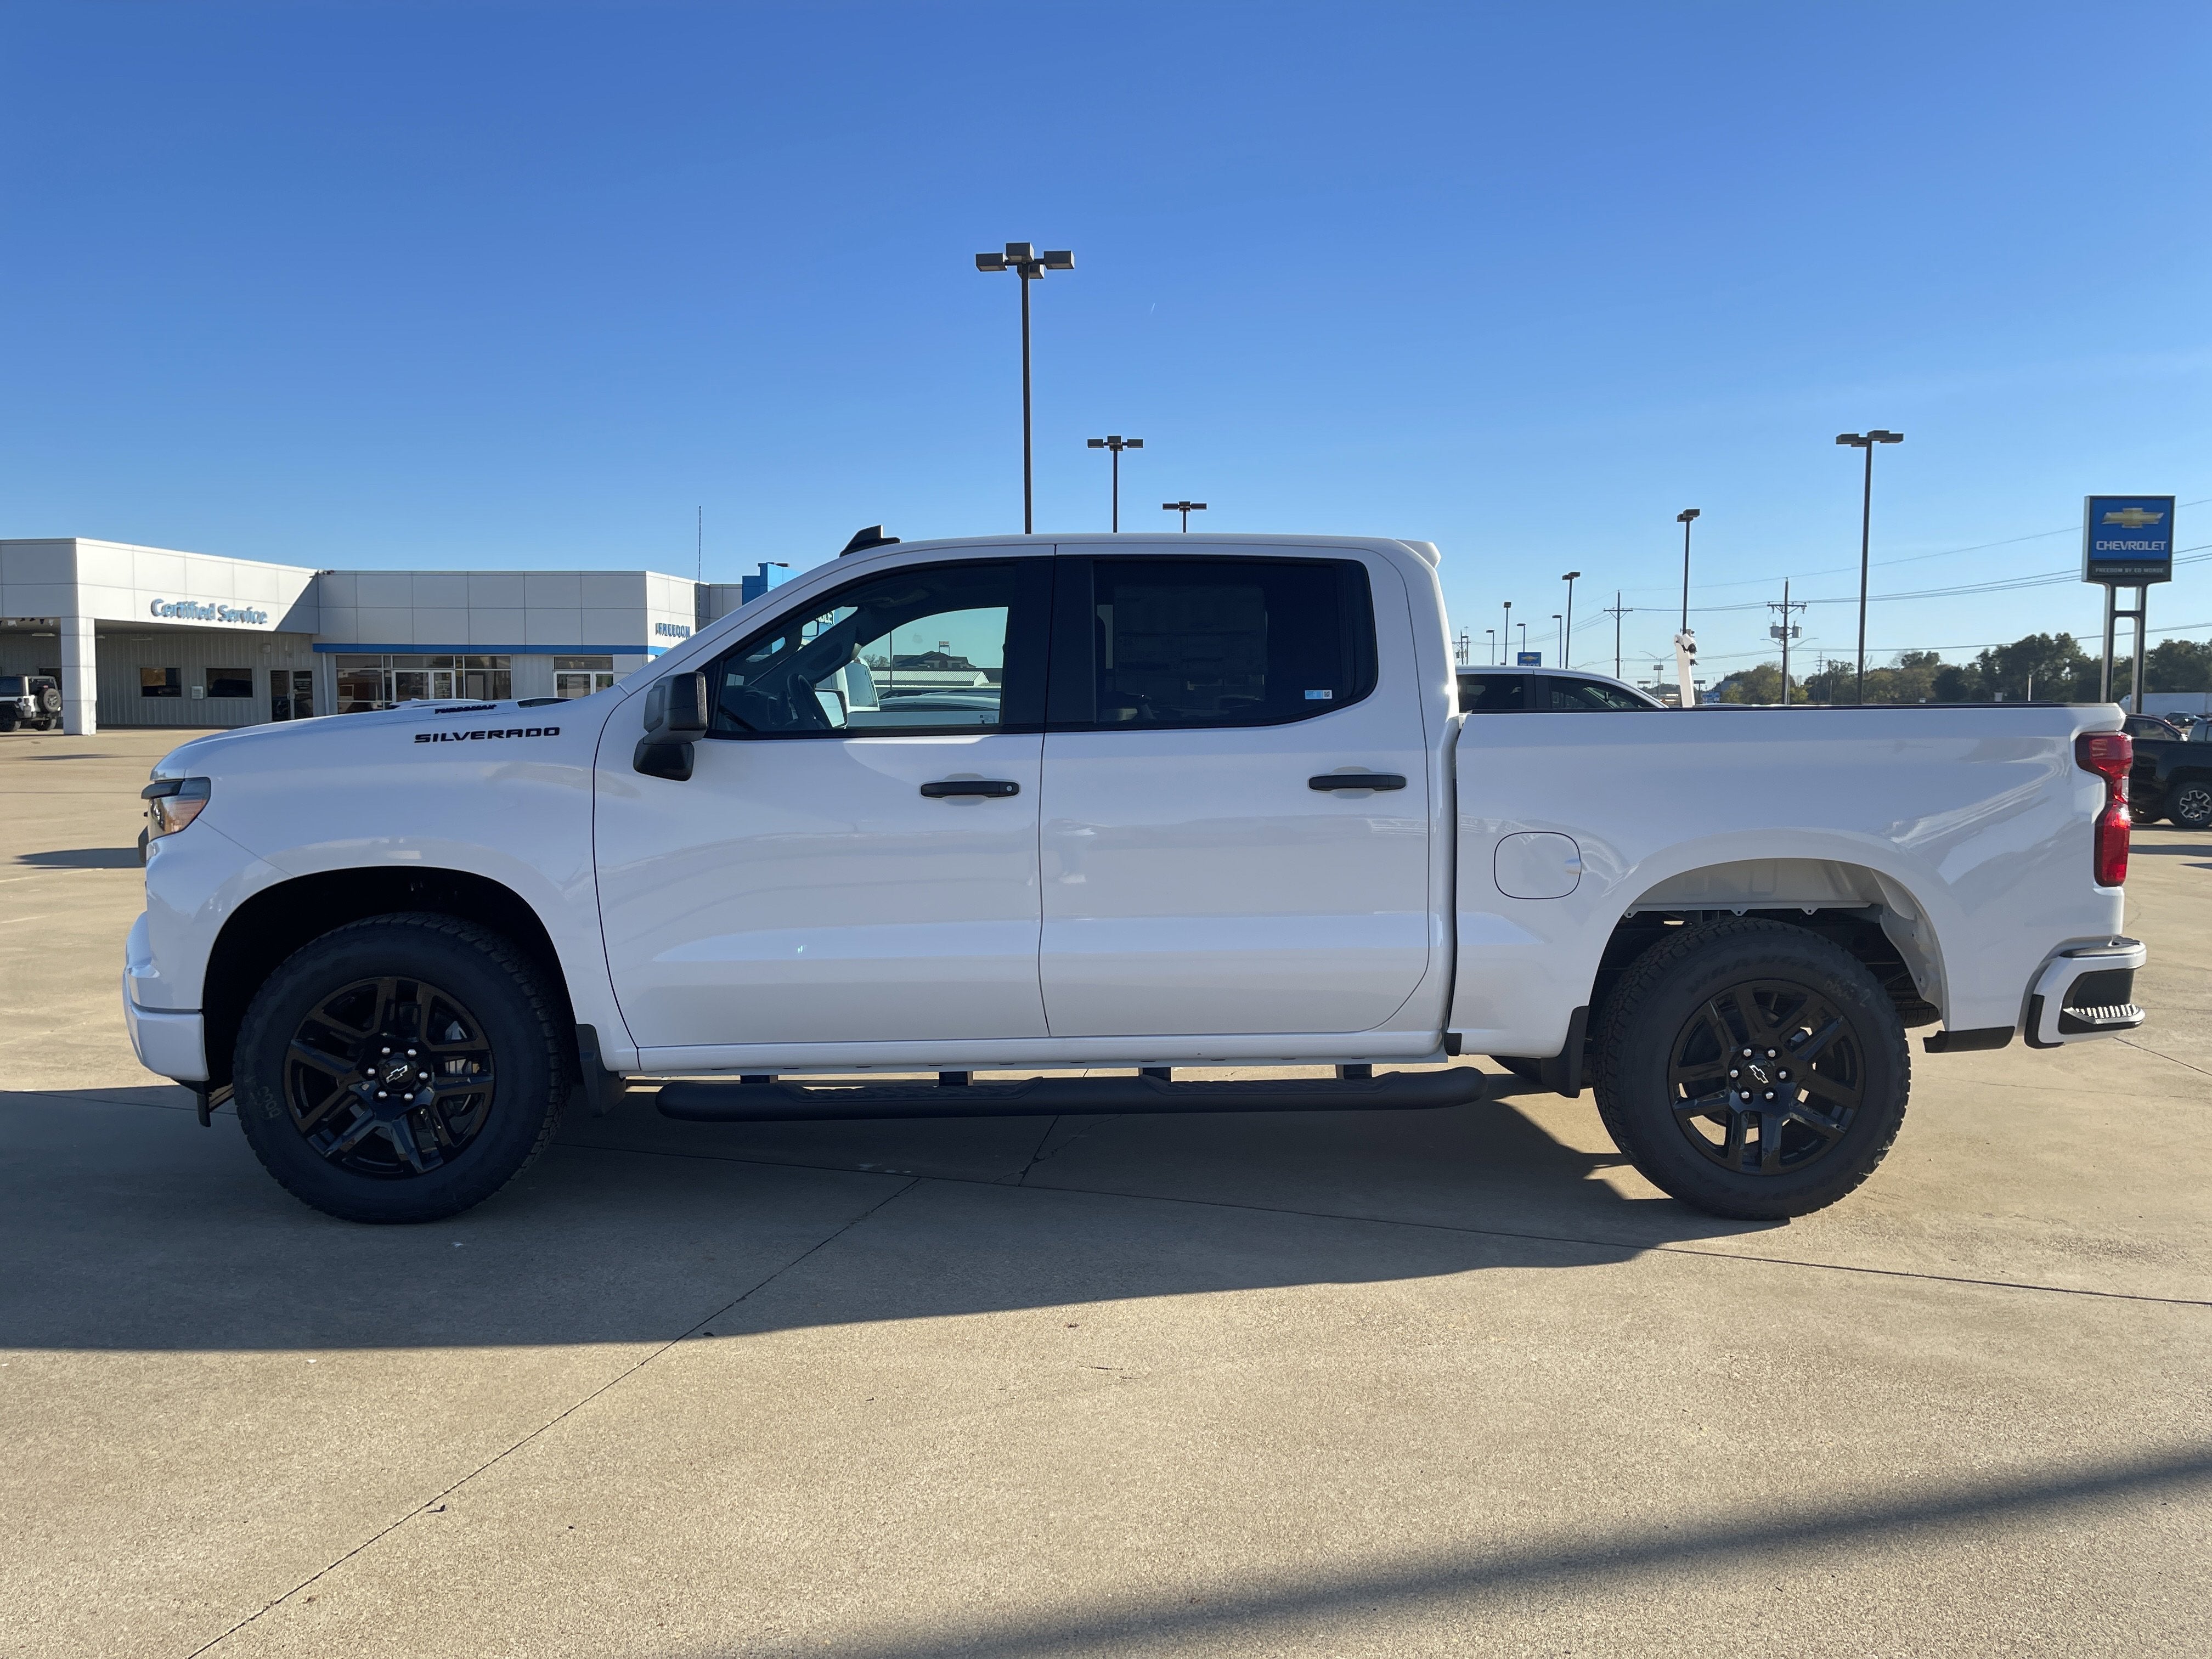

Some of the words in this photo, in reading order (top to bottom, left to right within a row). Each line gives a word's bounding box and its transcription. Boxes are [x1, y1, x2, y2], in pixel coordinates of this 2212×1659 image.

[2096, 540, 2166, 551] CHEVROLET
[151, 598, 216, 620] Certified
[217, 604, 268, 624] Service
[656, 622, 690, 638] FREEDOM
[414, 727, 561, 743] SILVERADO
